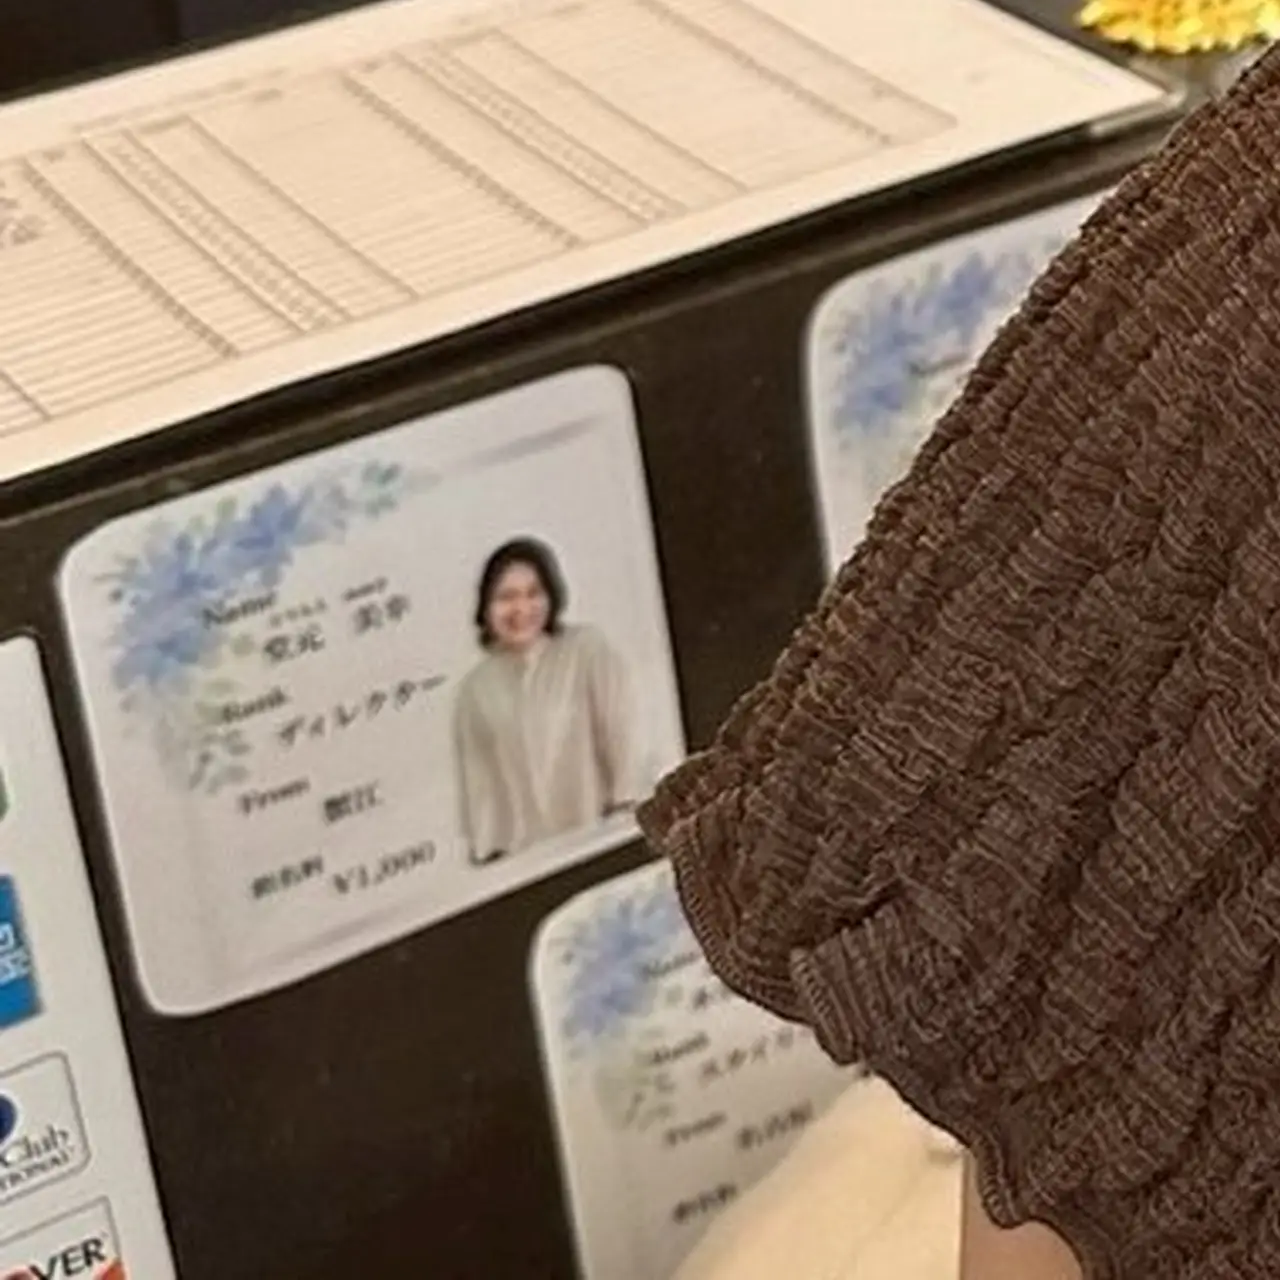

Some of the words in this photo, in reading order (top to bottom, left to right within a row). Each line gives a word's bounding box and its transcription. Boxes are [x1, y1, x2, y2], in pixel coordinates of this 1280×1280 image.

[277, 674, 447, 747] ディレクター
